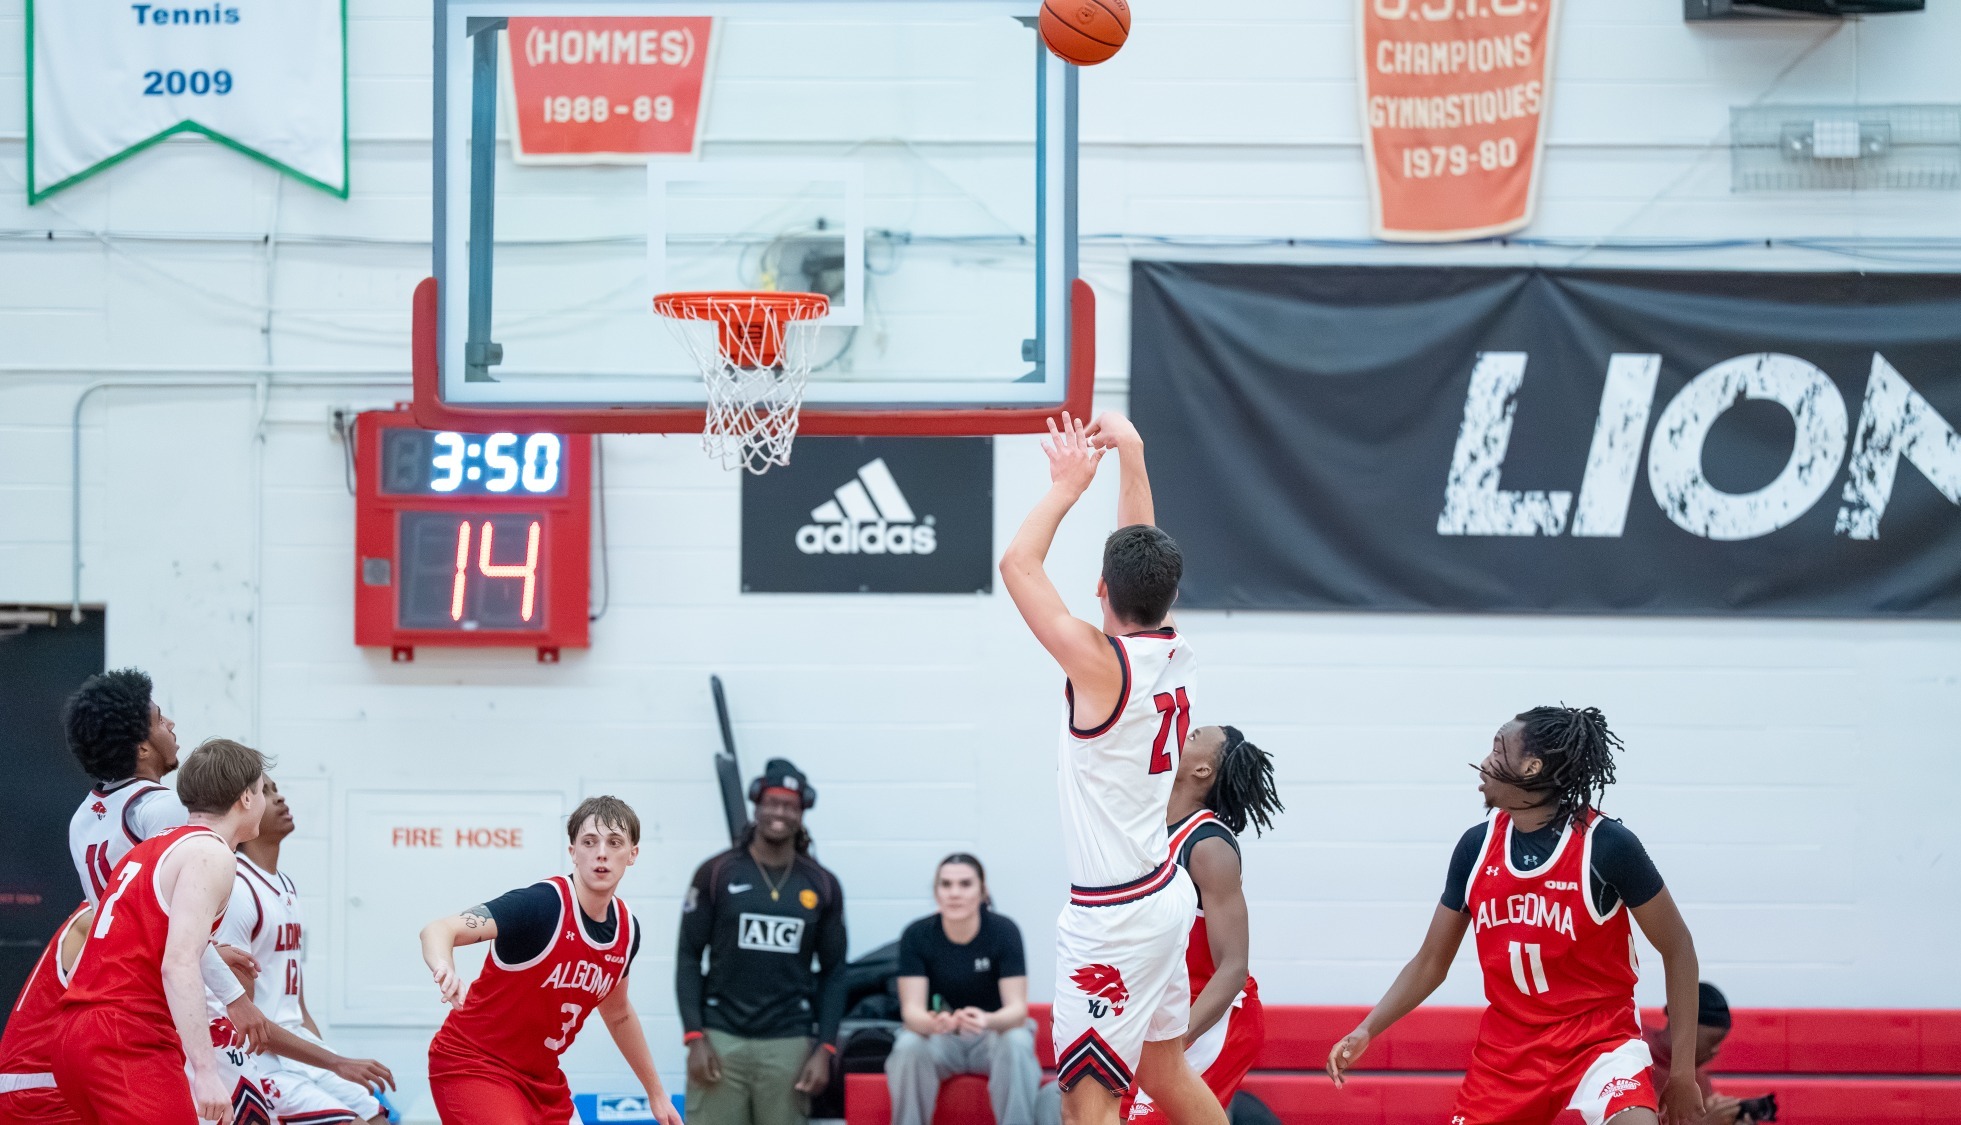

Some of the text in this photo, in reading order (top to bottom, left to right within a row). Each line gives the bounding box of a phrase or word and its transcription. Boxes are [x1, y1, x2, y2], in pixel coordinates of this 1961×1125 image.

[131, 2, 240, 26] Tennis
[525, 26, 695, 68] (HOMMES)
[1376, 31, 1533, 75] CHAMPIONS
[142, 69, 234, 96] 2009
[1368, 80, 1542, 129] GYMNASTIQUES
[1403, 136, 1518, 179] 1979-80
[430, 432, 561, 492] 3:50
[795, 516, 938, 555] adidas
[451, 520, 541, 621] 14
[1148, 686, 1190, 775] 21
[392, 827, 524, 849] FIRE HOSE
[1544, 880, 1579, 892] OUA
[745, 920, 798, 947] AIG
[1476, 892, 1577, 941] ALGOMA
[285, 959, 298, 995] 12
[1508, 940, 1550, 996] 11
[544, 1002, 582, 1051] 3
[1088, 999, 1109, 1019] YU
[226, 1049, 244, 1067] YU
